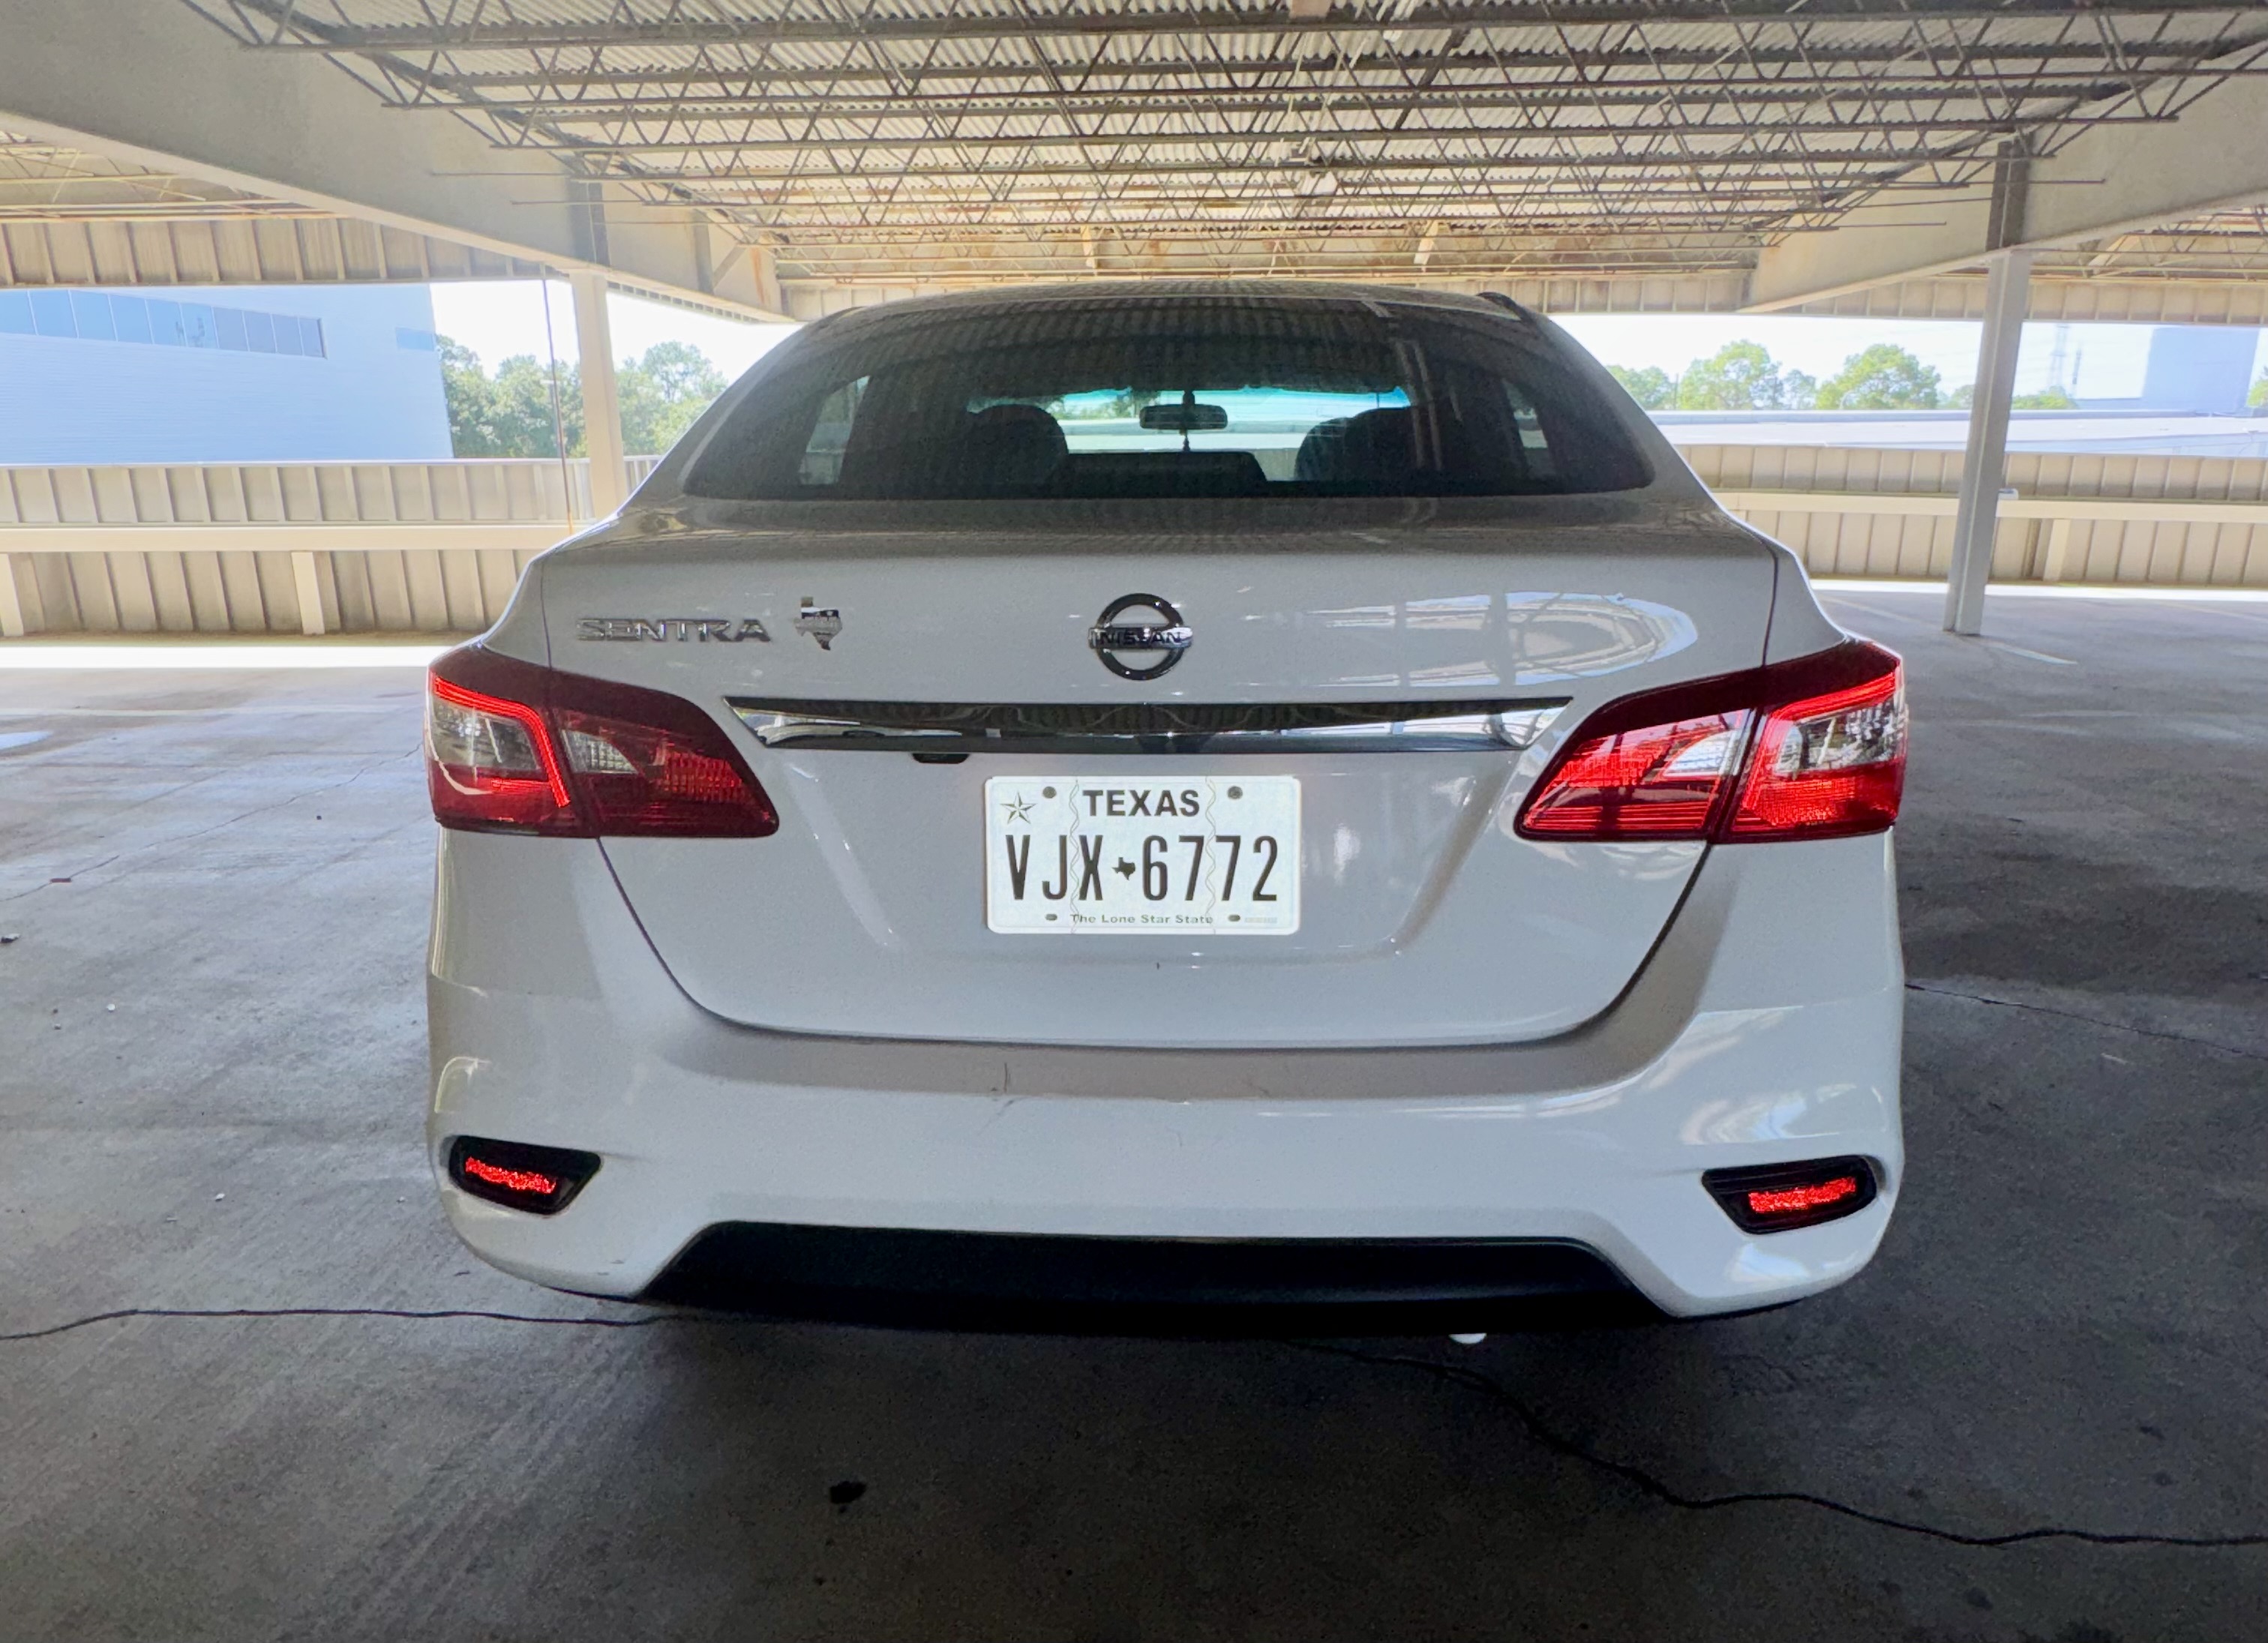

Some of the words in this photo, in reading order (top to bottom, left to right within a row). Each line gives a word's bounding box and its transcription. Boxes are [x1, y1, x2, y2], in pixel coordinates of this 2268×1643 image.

[577, 618, 771, 643] SENTRA
[1100, 631, 1182, 645] NISSAN
[1082, 790, 1200, 817] TEXAS
[1005, 835, 1104, 901] VJX
[1142, 835, 1278, 901] 6772
[1070, 913, 1096, 923] The
[1102, 914, 1136, 924] Lone
[1141, 914, 1170, 924] Star
[1175, 914, 1214, 924] State
